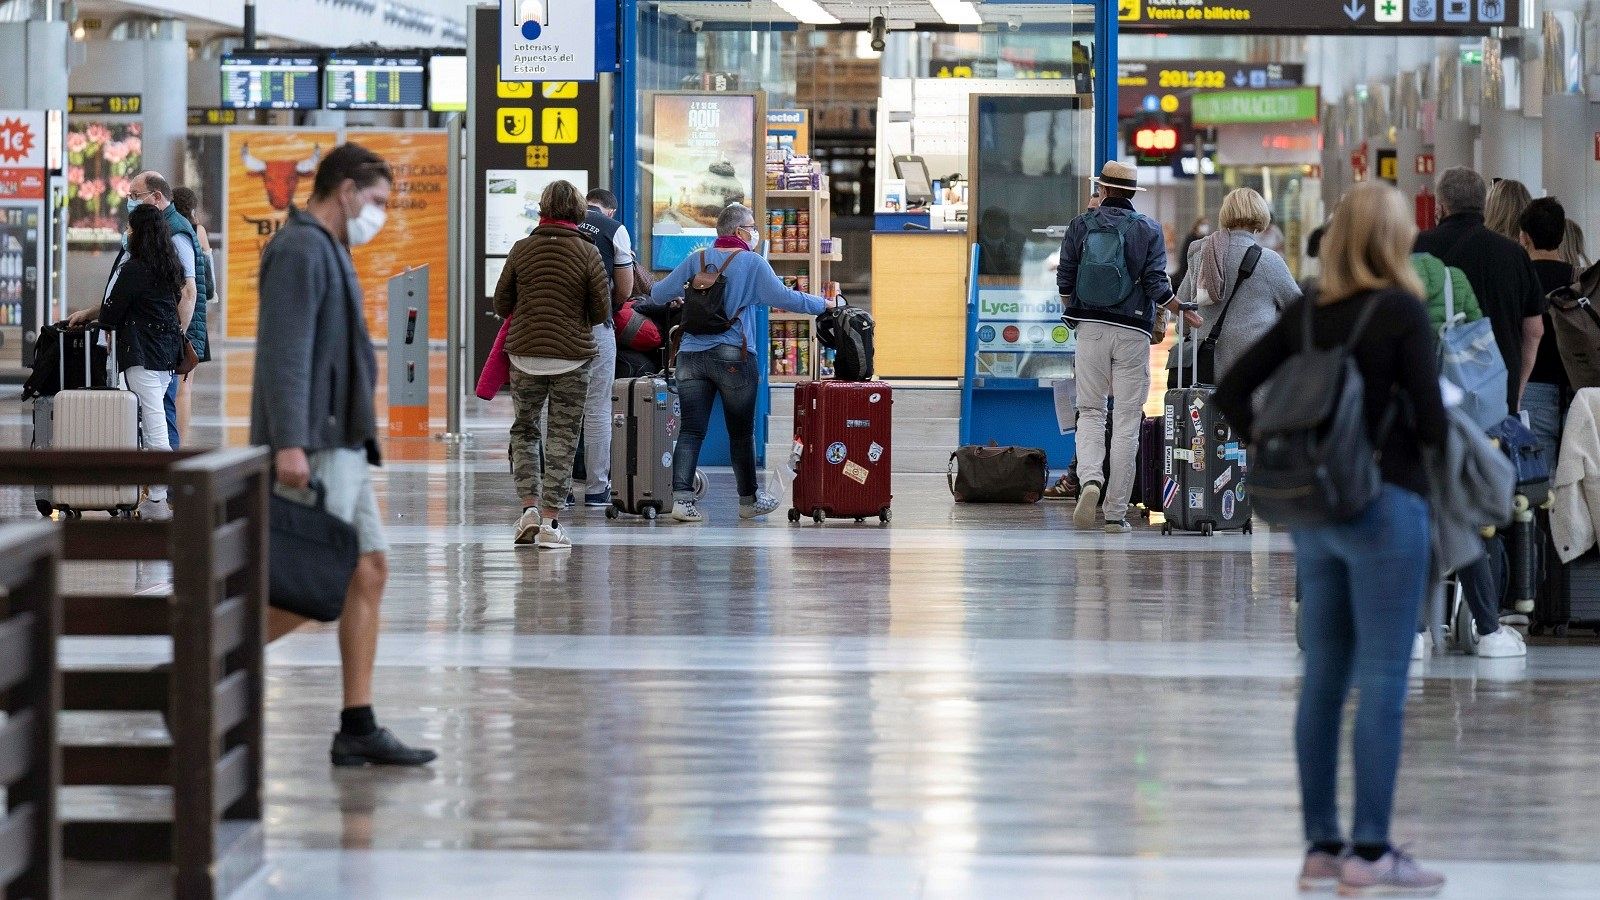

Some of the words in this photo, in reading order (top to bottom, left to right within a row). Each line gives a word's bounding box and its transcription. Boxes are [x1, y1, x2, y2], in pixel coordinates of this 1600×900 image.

[1147, 6, 1185, 20] Venta
[1185, 6, 1203, 20] de
[1203, 6, 1251, 20] billetes
[514, 54, 558, 64] Apuestas
[559, 53, 575, 63] del
[514, 64, 547, 74] Estado
[0, 127, 25, 152] 1€
[981, 297, 1066, 316] Lycamobil
